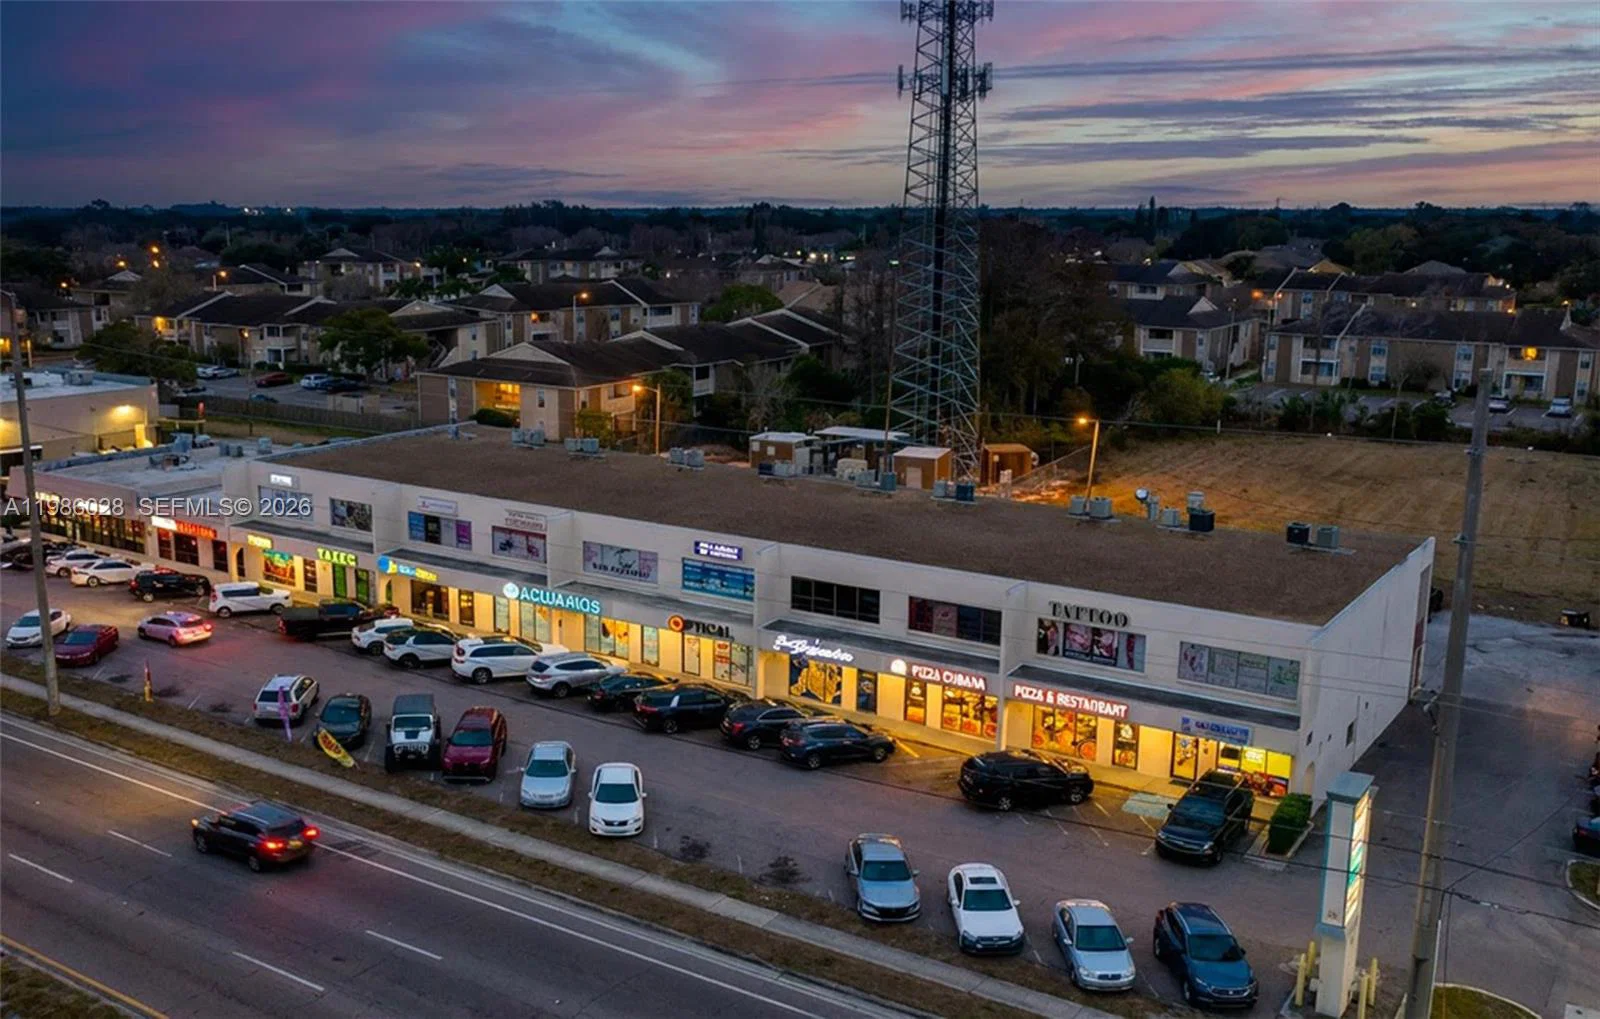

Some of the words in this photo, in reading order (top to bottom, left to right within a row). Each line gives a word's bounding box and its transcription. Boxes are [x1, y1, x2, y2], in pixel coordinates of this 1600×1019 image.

[1048, 600, 1129, 628] TATTOO
[911, 665, 941, 682] PIZZA
[942, 670, 986, 691] CUBANA
[1014, 684, 1044, 702] PIZZA
[1056, 693, 1128, 718] RESTAURANT
